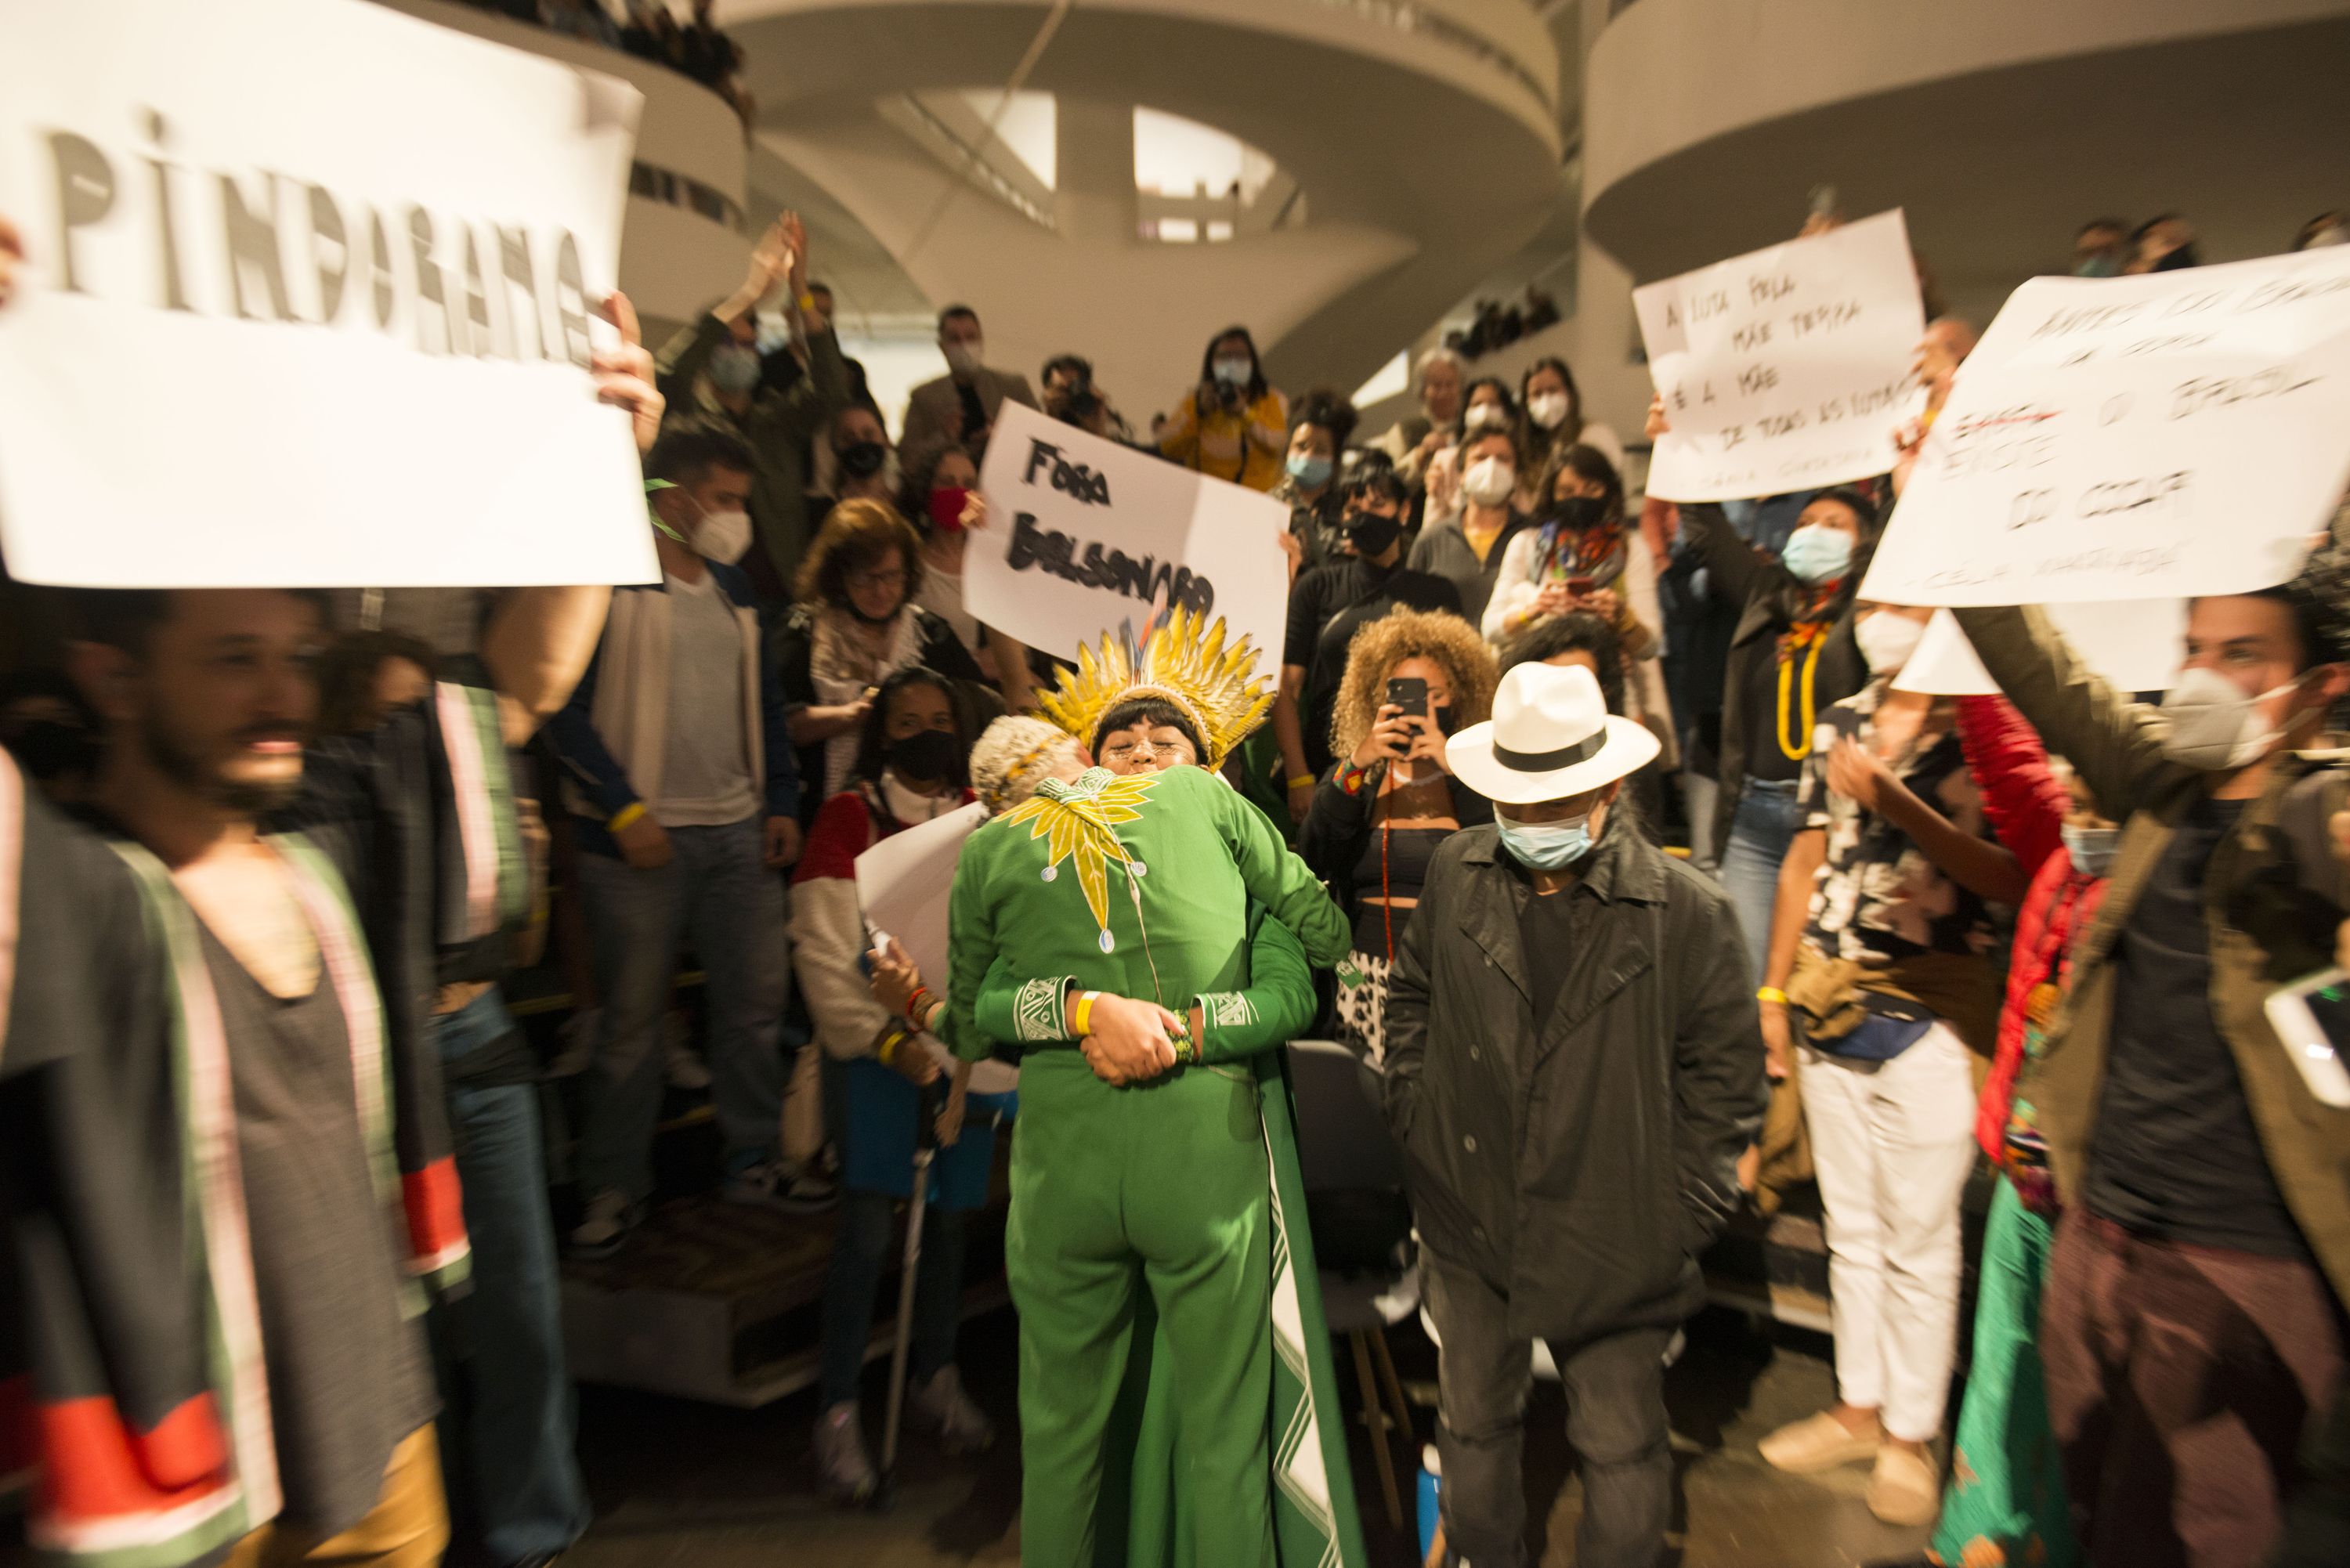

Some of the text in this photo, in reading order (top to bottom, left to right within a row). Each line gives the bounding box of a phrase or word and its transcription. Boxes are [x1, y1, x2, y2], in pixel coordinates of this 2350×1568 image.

[1666, 273, 1796, 329] A LUTA PELA
[1702, 381, 1716, 405] A
